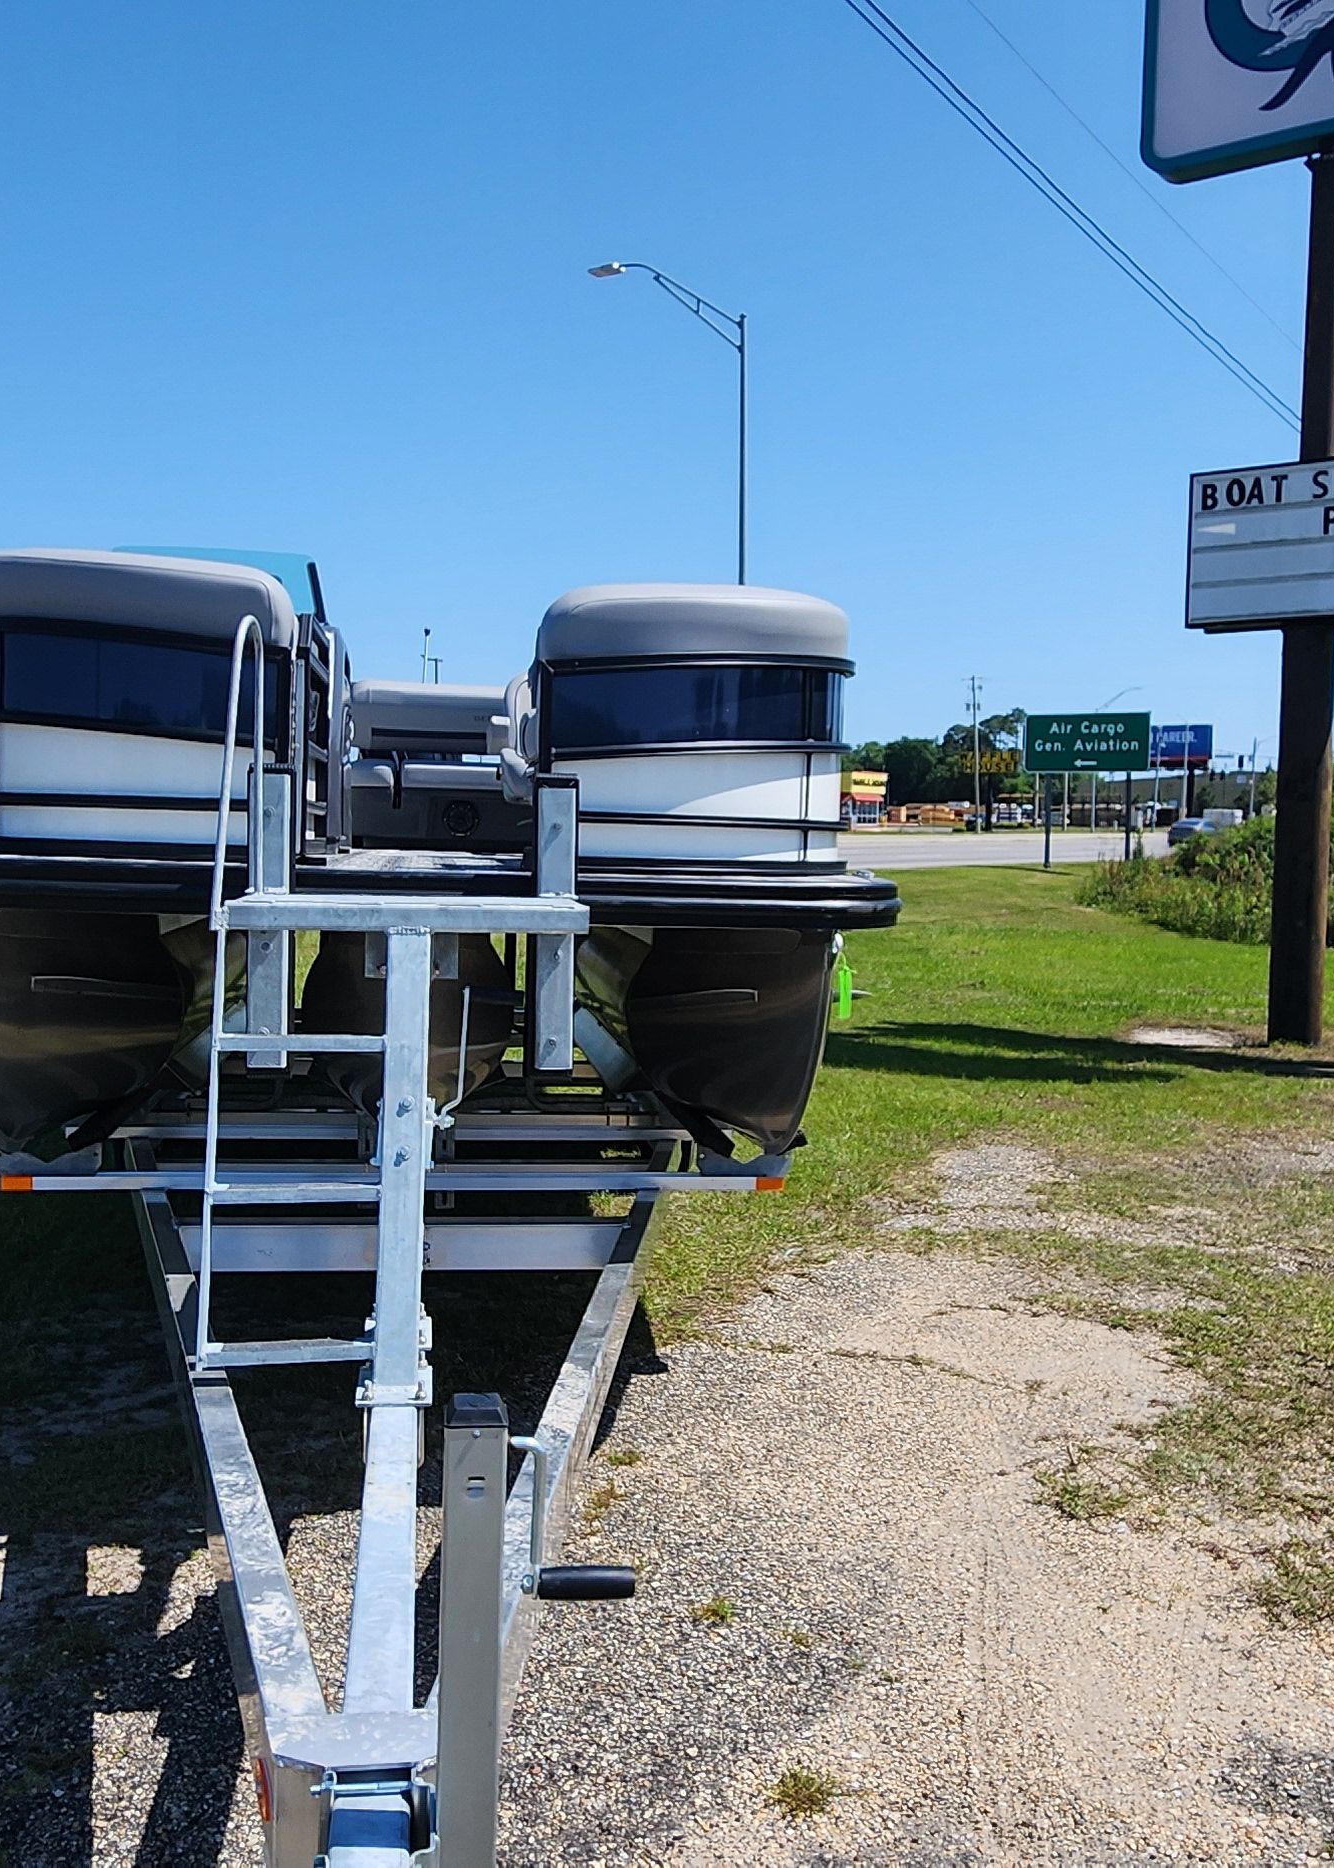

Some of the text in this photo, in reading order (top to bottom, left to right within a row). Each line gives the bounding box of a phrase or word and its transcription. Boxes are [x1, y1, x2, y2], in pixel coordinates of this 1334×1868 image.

[1201, 474, 1289, 511] BOAT
[1049, 721, 1125, 736] Air Cargo
[1034, 738, 1139, 752] Gen. Aviation
